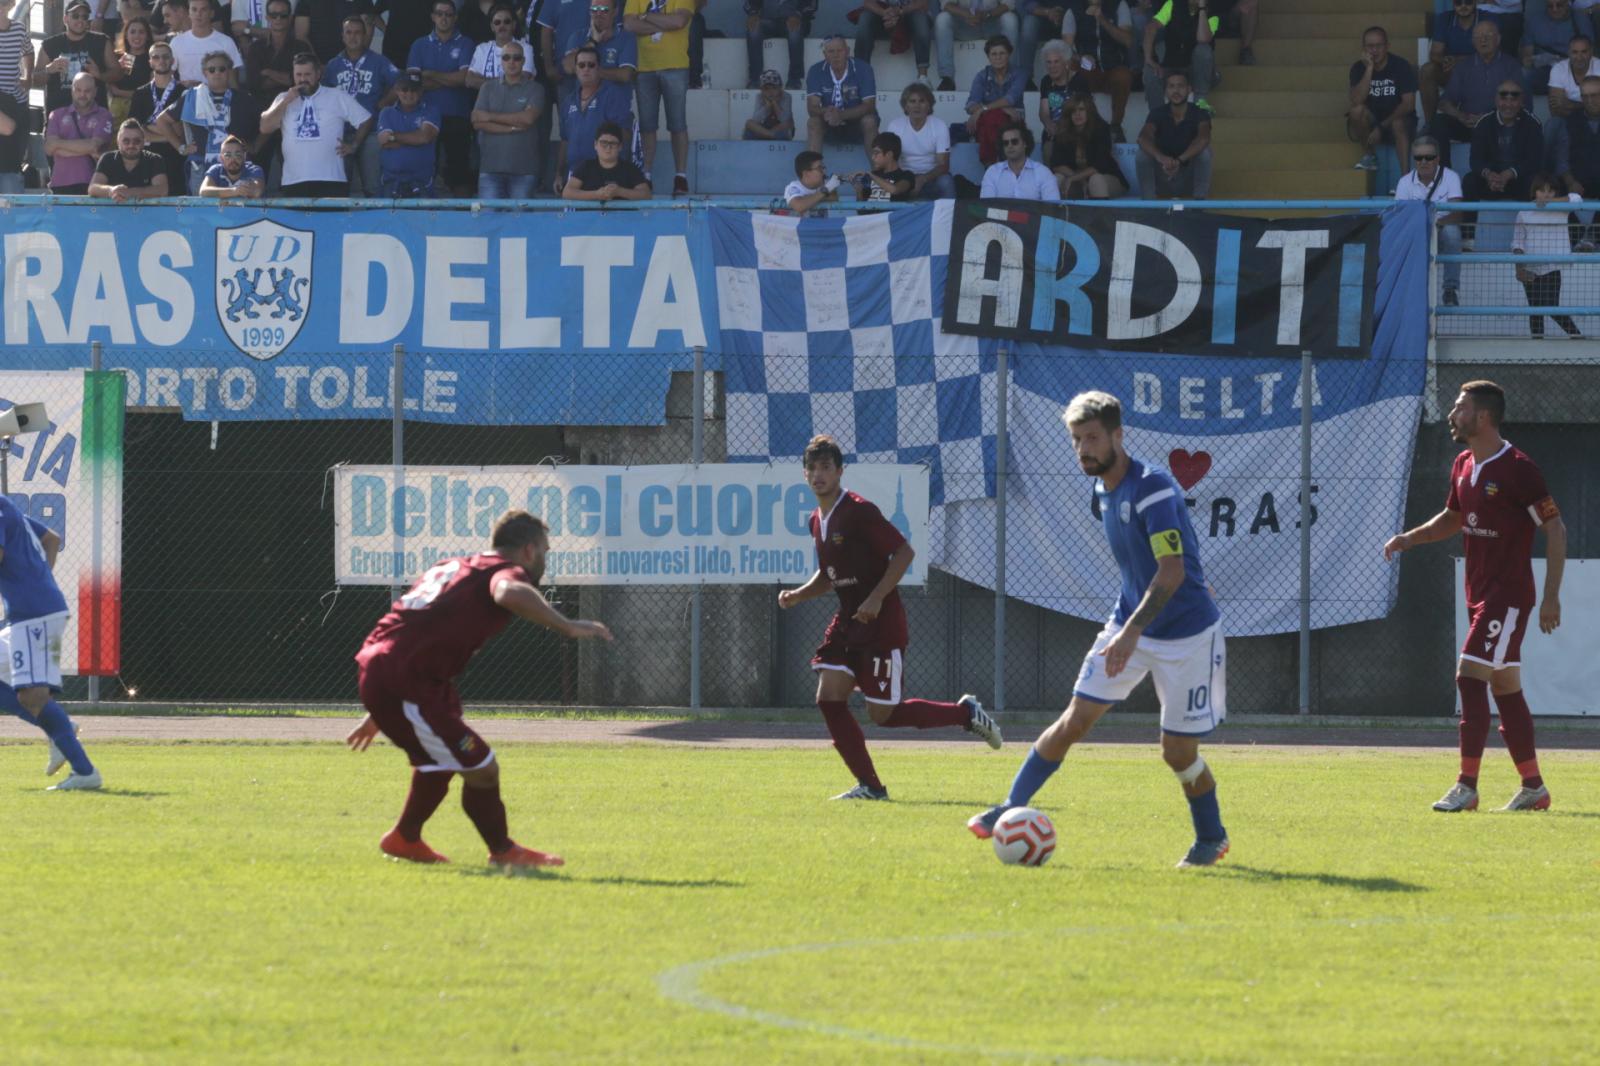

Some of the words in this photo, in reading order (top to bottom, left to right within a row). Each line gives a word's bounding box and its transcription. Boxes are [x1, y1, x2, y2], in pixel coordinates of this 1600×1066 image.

[337, 69, 373, 84] POTO
[4, 230, 195, 346] RAS
[339, 233, 708, 349] DELTA
[956, 214, 1366, 348] ARDITI
[242, 327, 285, 347] 1999
[100, 366, 257, 411] RTO
[275, 364, 458, 413] TOLLE
[1133, 364, 1323, 420] DELTA
[351, 473, 509, 538] Delta
[527, 475, 622, 538] nel
[638, 483, 818, 538] cuore
[351, 546, 417, 578] Gruppo
[545, 547, 602, 578] granti
[607, 546, 690, 575] novaresi
[740, 545, 809, 577] Franco,
[1486, 619, 1502, 638] 9
[12, 650, 24, 669] 8
[872, 657, 892, 678] 11
[1187, 684, 1208, 712] 10
